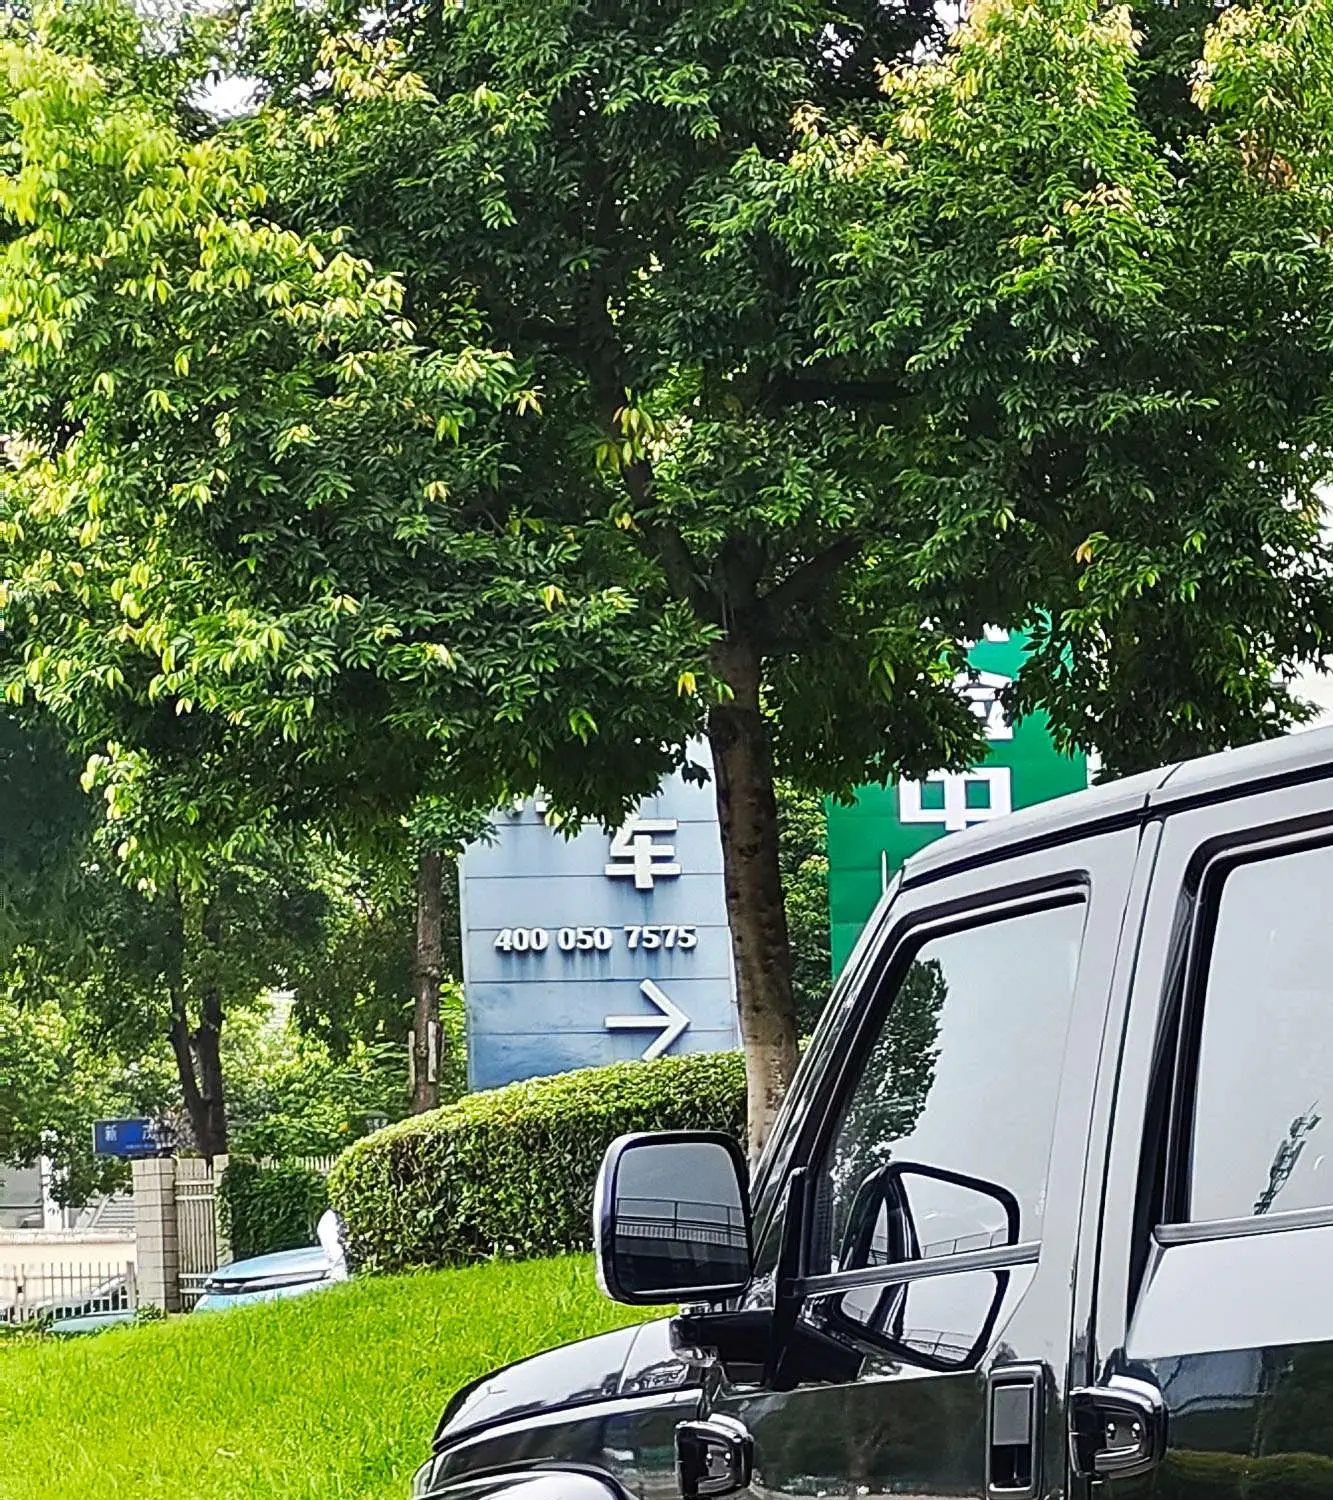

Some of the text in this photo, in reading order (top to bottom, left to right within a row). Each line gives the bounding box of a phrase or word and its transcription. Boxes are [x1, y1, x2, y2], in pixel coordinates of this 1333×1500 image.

[494, 924, 697, 951] 400 050 7575
